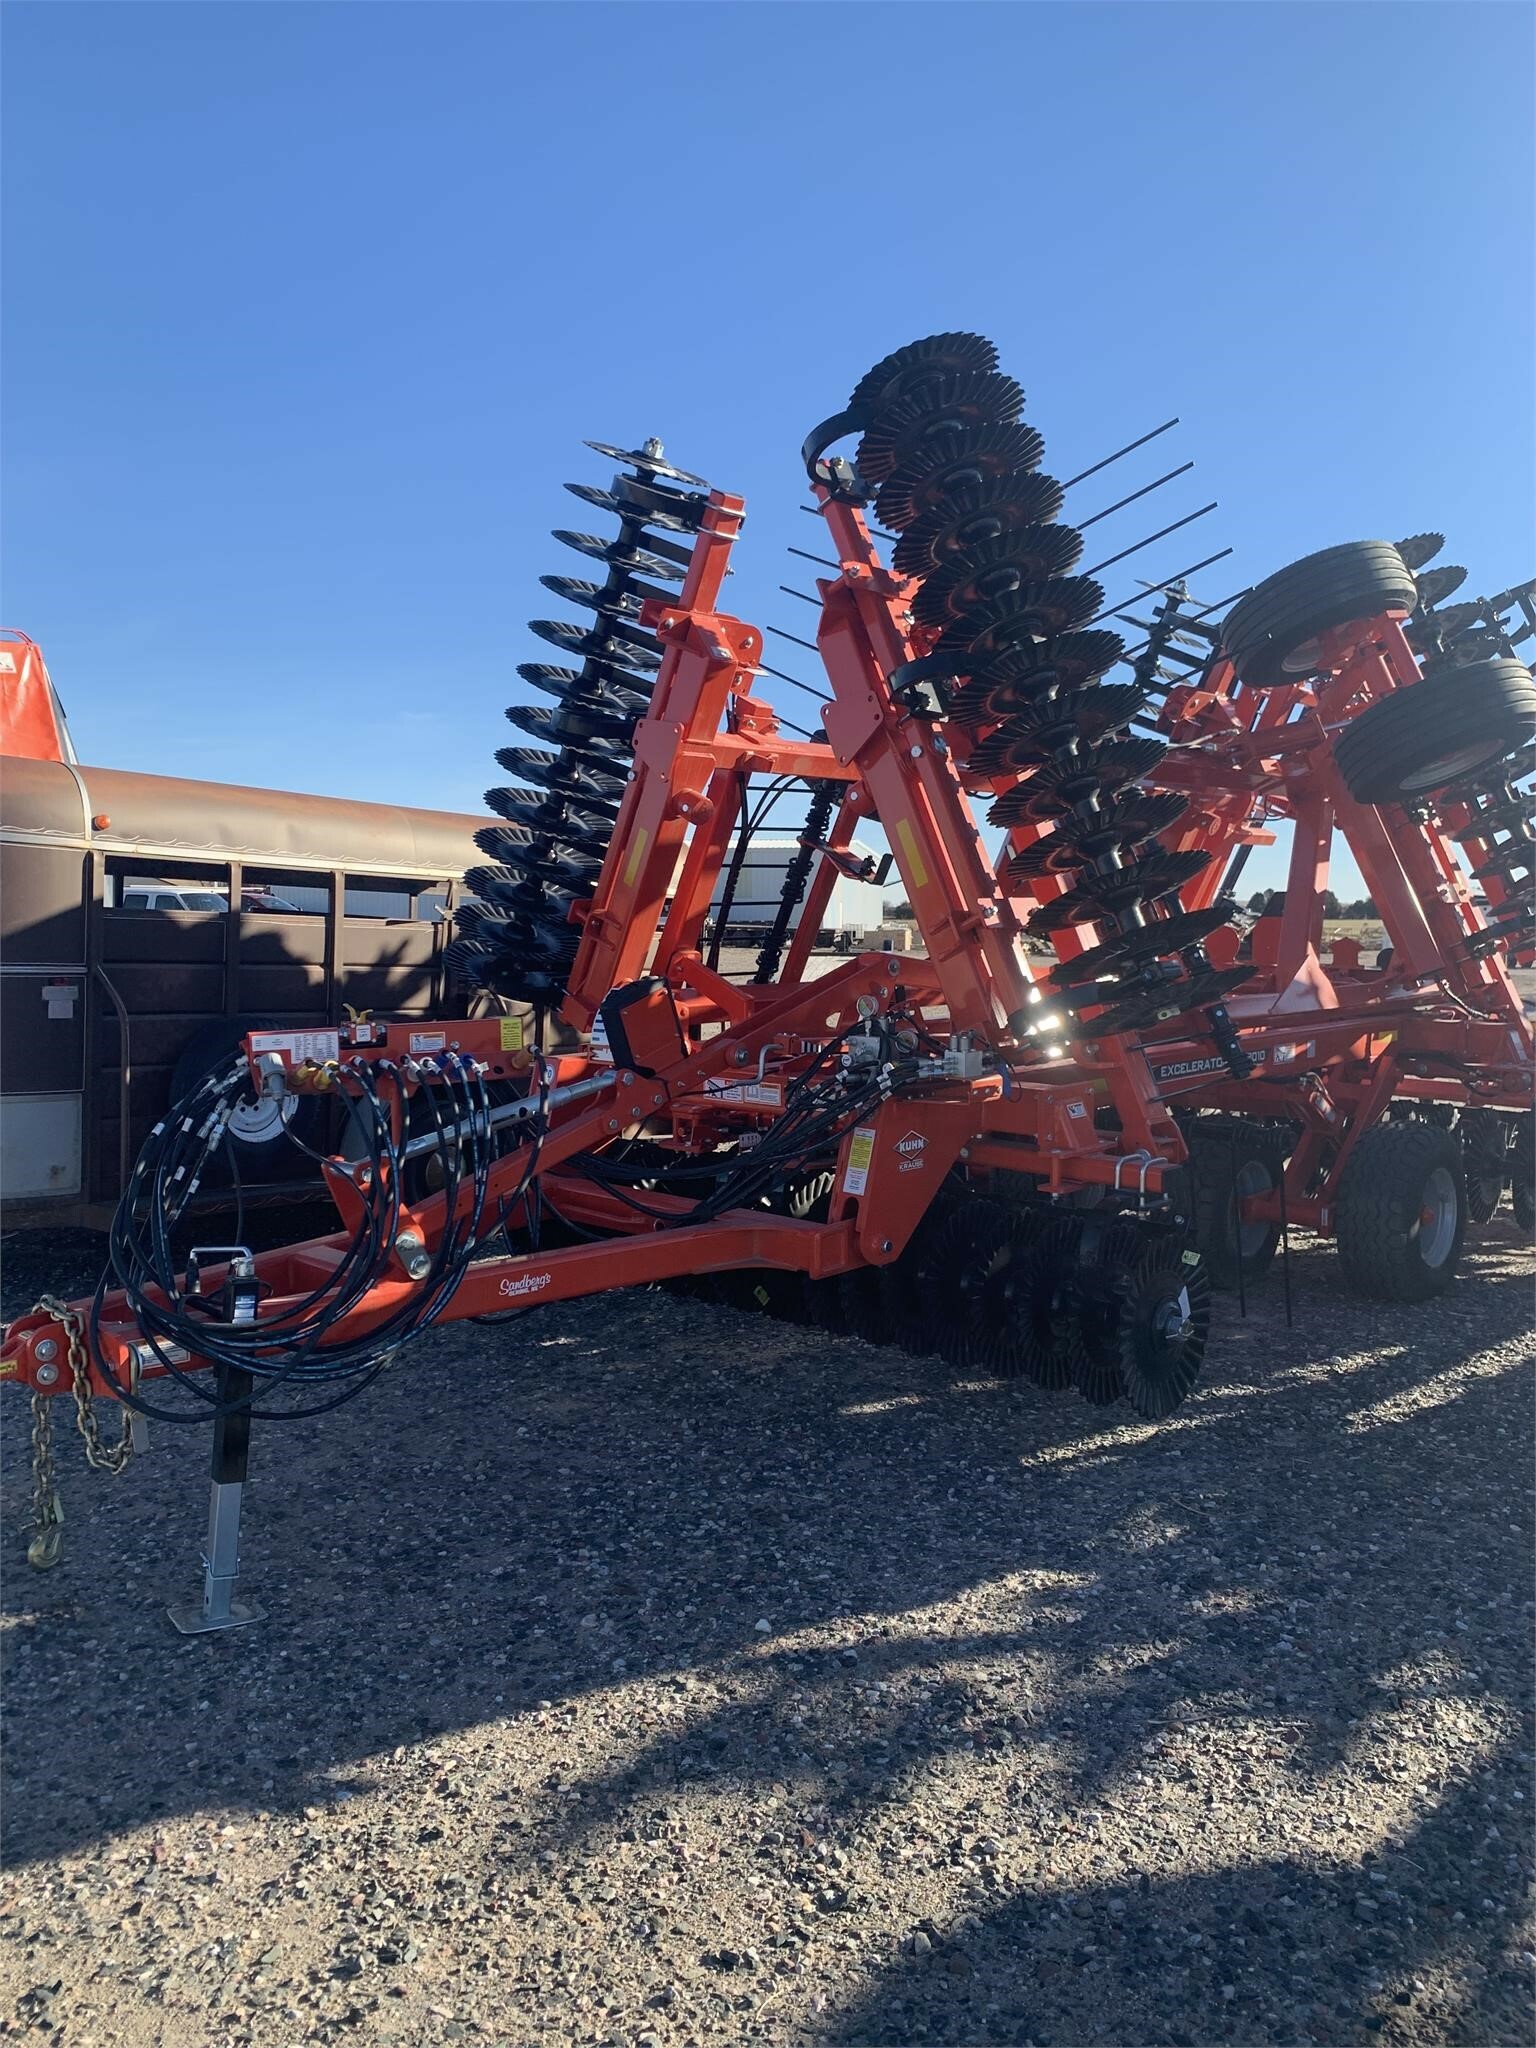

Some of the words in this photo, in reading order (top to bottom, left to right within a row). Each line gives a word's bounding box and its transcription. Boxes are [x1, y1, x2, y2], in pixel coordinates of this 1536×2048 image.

[1160, 1057, 1228, 1077] EXCELERATO
[899, 1139, 924, 1152] KUHN
[498, 1273, 551, 1296] Sandberg's
